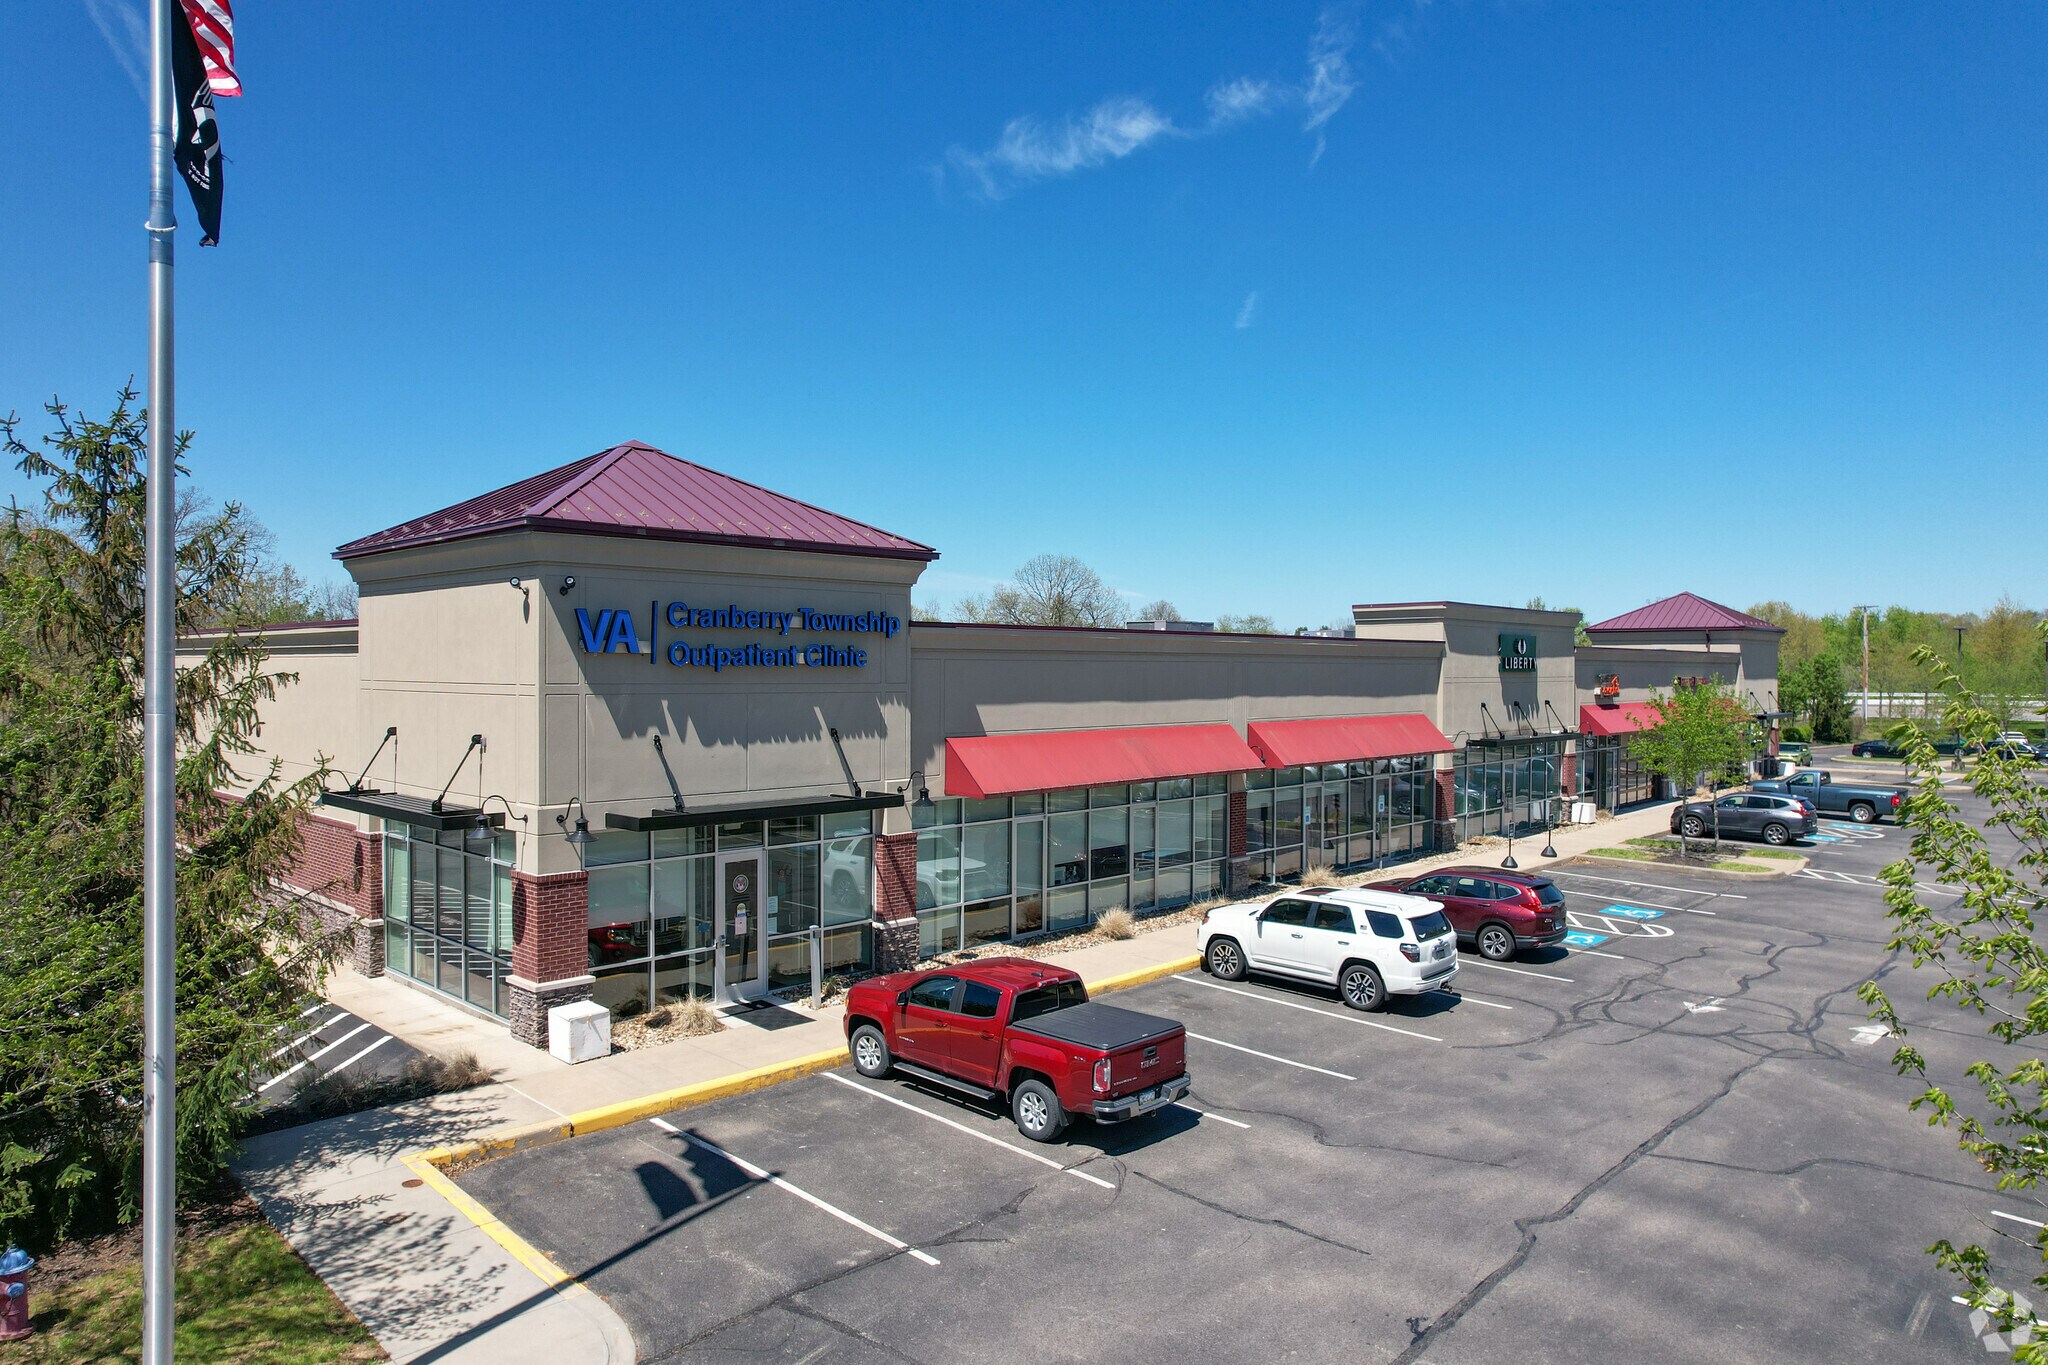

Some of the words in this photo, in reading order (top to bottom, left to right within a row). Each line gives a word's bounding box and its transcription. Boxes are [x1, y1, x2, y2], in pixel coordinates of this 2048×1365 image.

[574, 607, 640, 654] VA
[666, 601, 793, 636] Cranberry
[798, 607, 901, 639] Township
[667, 641, 799, 672] Outpatient
[803, 643, 868, 668] Clinic
[1505, 657, 1537, 669] LIBERTY
